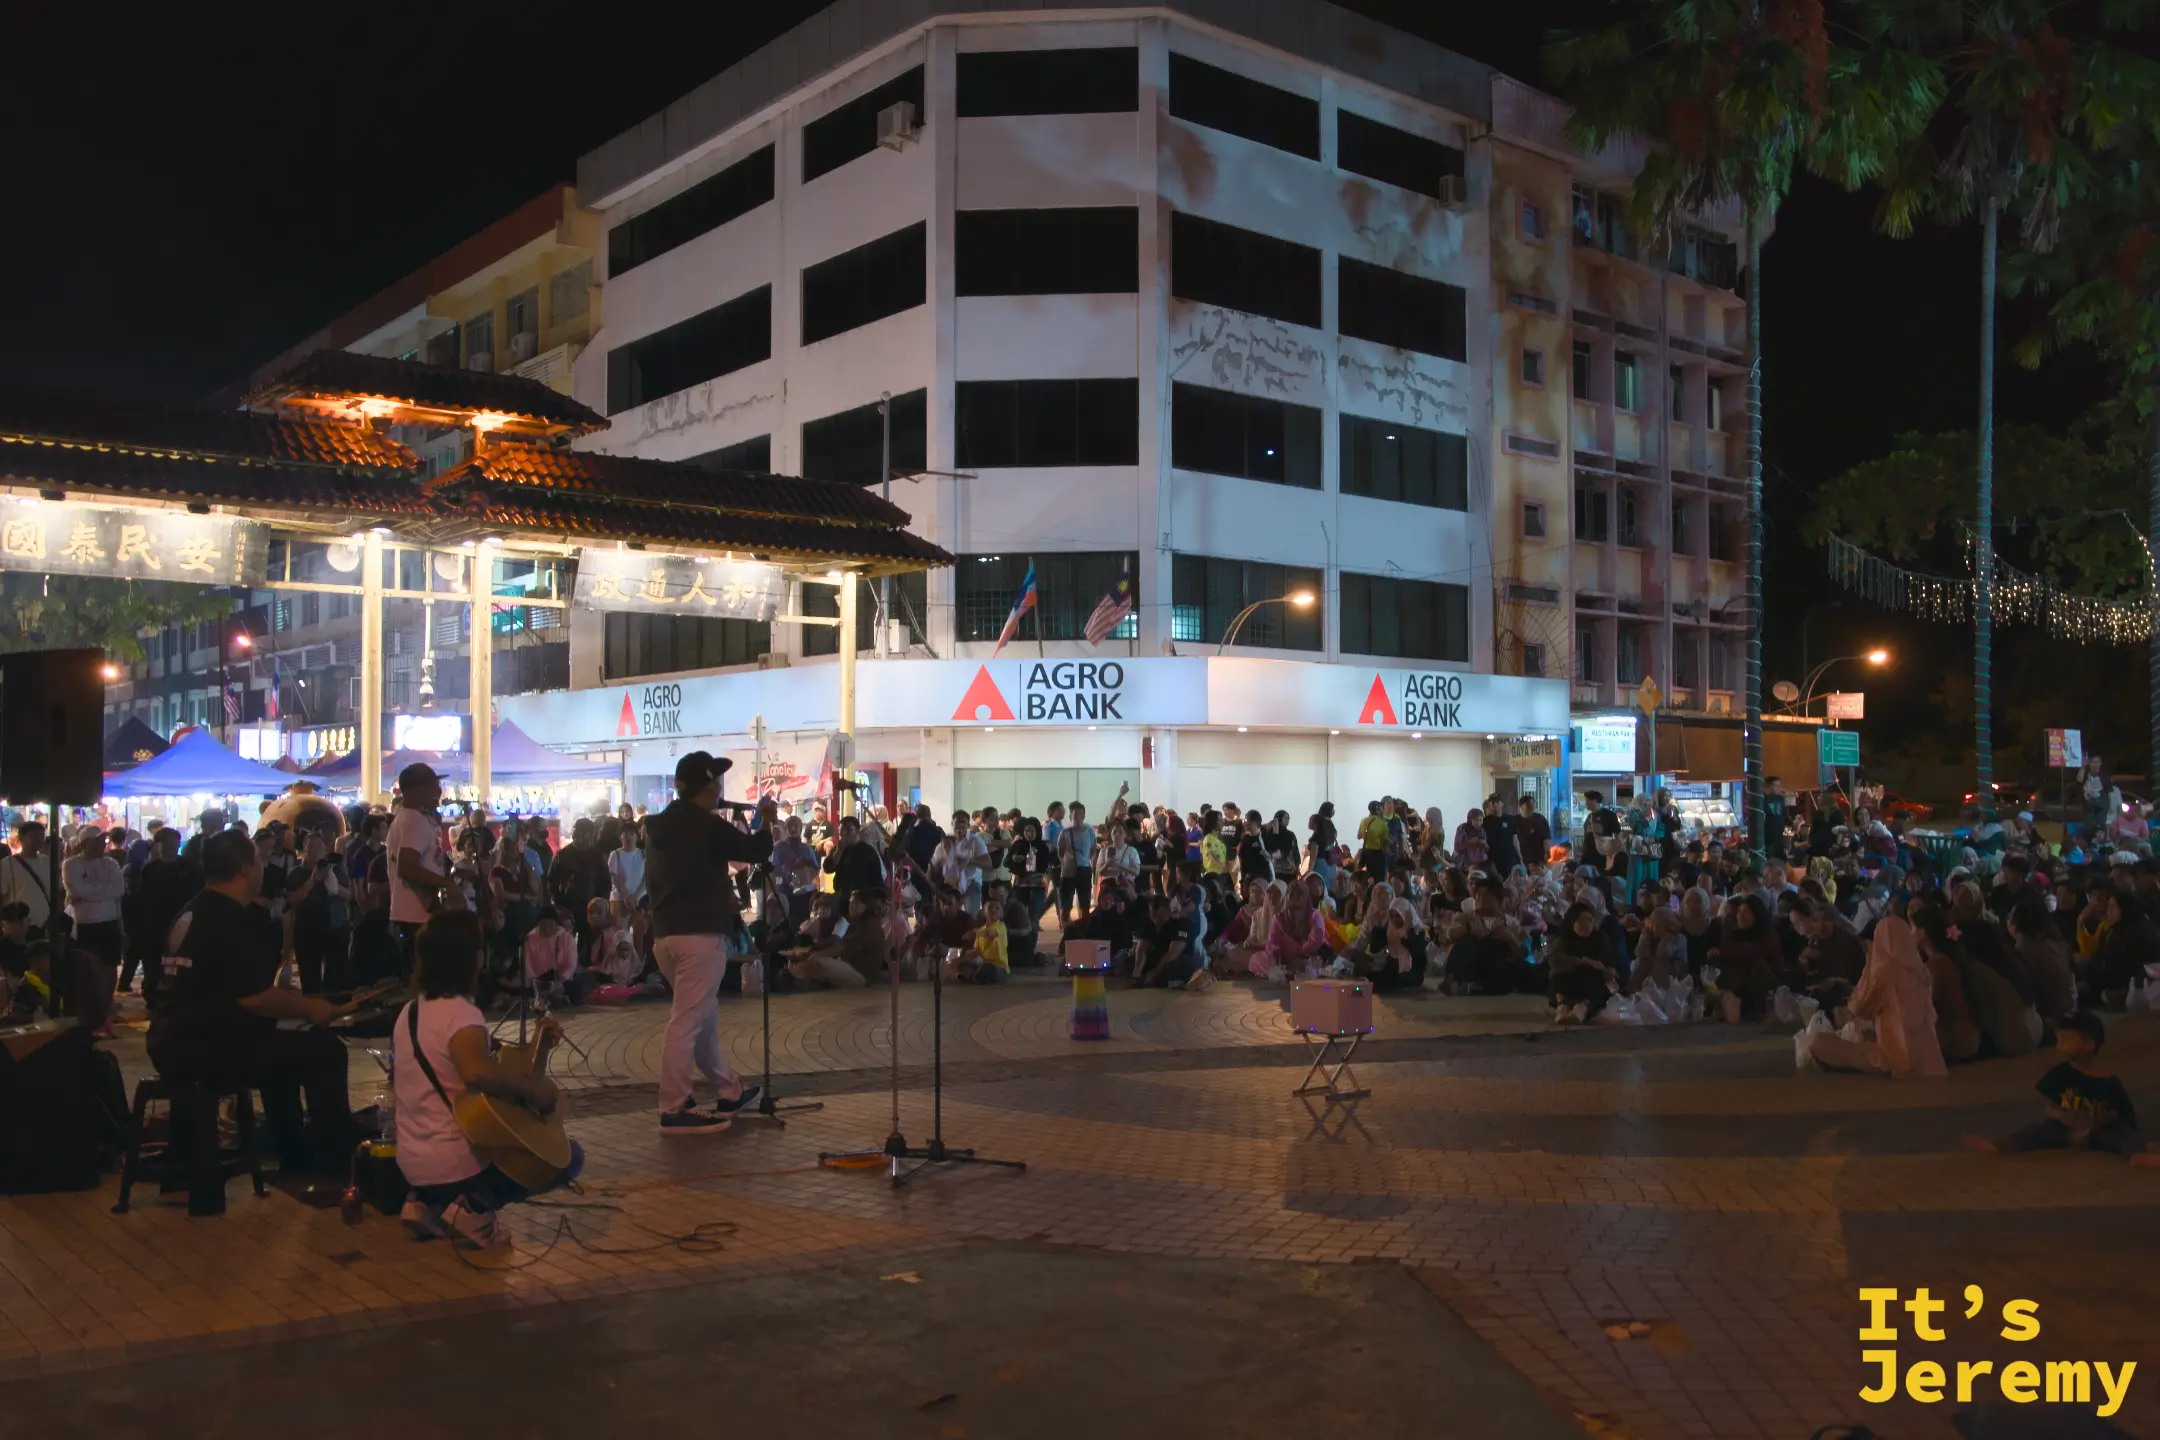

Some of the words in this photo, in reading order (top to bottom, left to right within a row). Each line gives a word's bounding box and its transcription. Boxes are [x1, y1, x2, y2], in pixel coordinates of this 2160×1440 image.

[2, 518, 222, 575] 國泰民安
[1026, 662, 1124, 690] AGRO
[1405, 674, 1462, 701] AGRO
[643, 684, 682, 709] AGRO
[1027, 693, 1123, 720] BANK
[644, 710, 682, 735] BANK
[1405, 701, 1462, 727] BANK
[1511, 745, 1529, 758] GAYA
[1531, 743, 1554, 757] HOTEL
